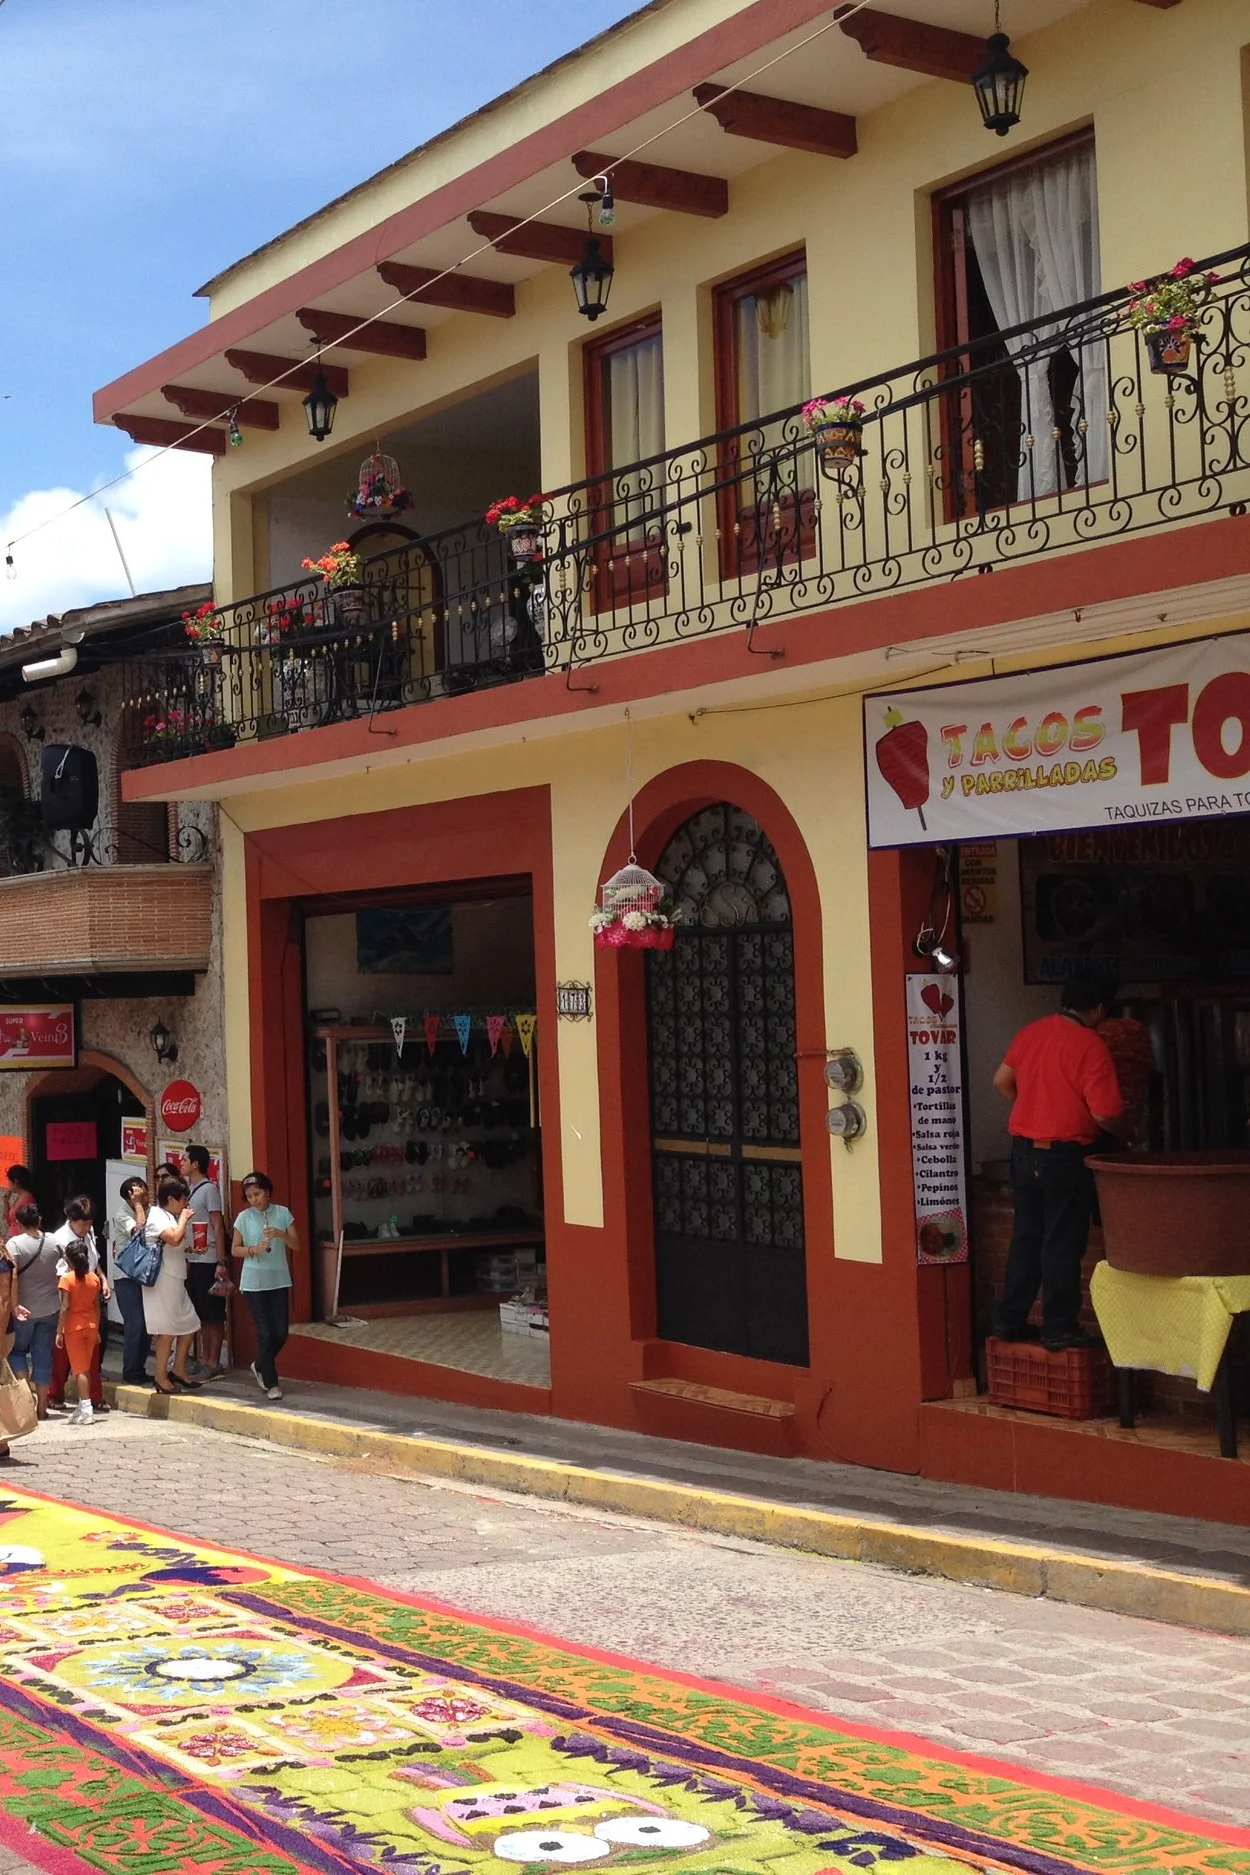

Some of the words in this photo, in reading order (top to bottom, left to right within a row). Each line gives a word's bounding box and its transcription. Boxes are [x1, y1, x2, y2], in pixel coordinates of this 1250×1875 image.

[1121, 672, 1250, 785] TO
[941, 705, 1106, 768] TACOS
[1105, 799, 1183, 821] TAQUIZAS
[1186, 794, 1232, 812] PARA
[5, 1017, 24, 1025] SUPER
[910, 1030, 957, 1045] TOVAR
[934, 1050, 948, 1063] kg
[928, 1073, 947, 1086] 1/2
[911, 1085, 925, 1095] de
[927, 1085, 961, 1097] pastor
[161, 1097, 199, 1116] Coca-Cola
[918, 1116, 930, 1125] de
[915, 1130, 941, 1139] Salsa
[916, 1143, 938, 1151] Salsa
[940, 1143, 960, 1151] verde
[921, 1155, 957, 1164] Cebolla
[919, 1170, 959, 1178] Cilantro
[921, 1183, 958, 1193] Pepinos
